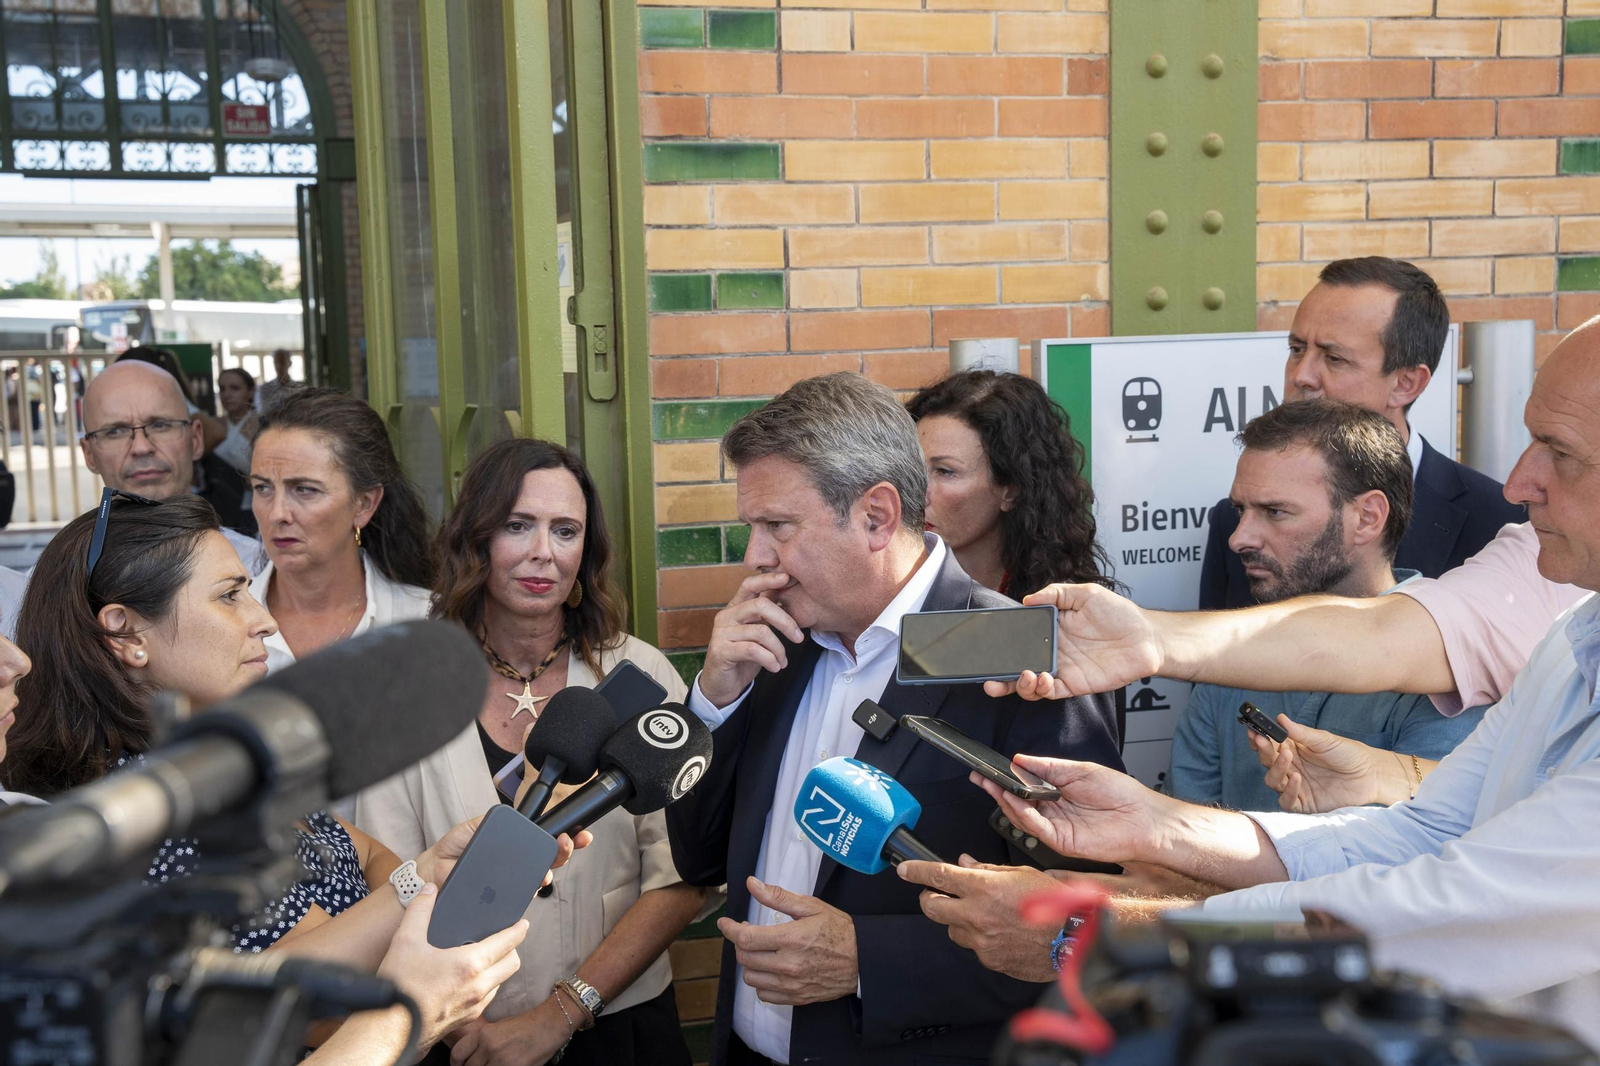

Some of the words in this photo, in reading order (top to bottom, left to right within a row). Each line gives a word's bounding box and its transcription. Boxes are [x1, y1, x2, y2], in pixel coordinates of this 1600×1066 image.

[236, 107, 257, 118] SIN
[227, 120, 267, 131] SALIDA
[1122, 546, 1202, 565] WELCOME
[653, 718, 673, 736] intv
[832, 812, 855, 852] CanalSur
[840, 817, 863, 857] NOTICIAS
